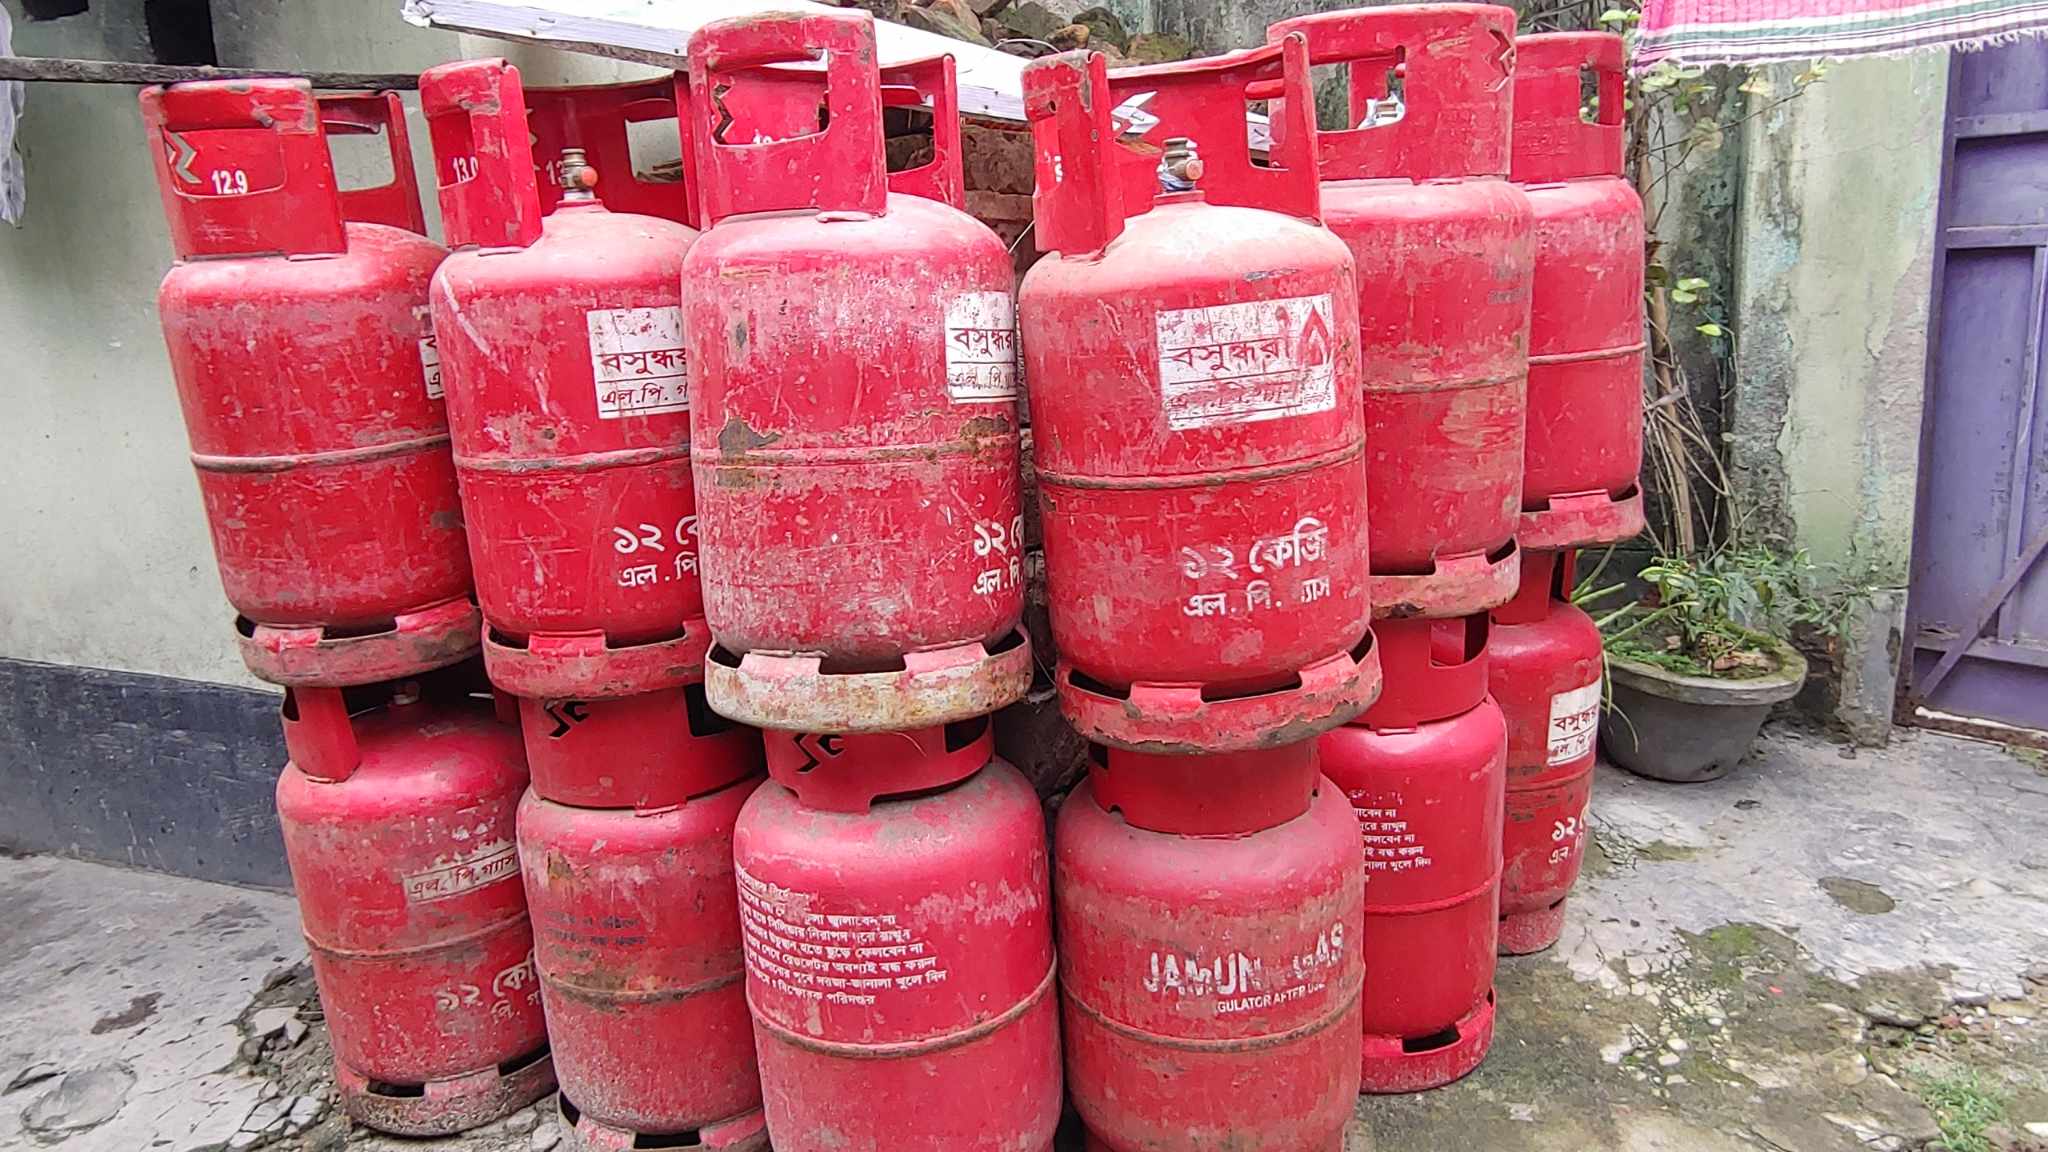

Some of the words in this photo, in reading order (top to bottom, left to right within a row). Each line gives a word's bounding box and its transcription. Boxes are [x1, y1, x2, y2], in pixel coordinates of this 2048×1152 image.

[211, 169, 249, 194] 12.9
[452, 156, 479, 183] 130
[612, 523, 665, 554] ১২
